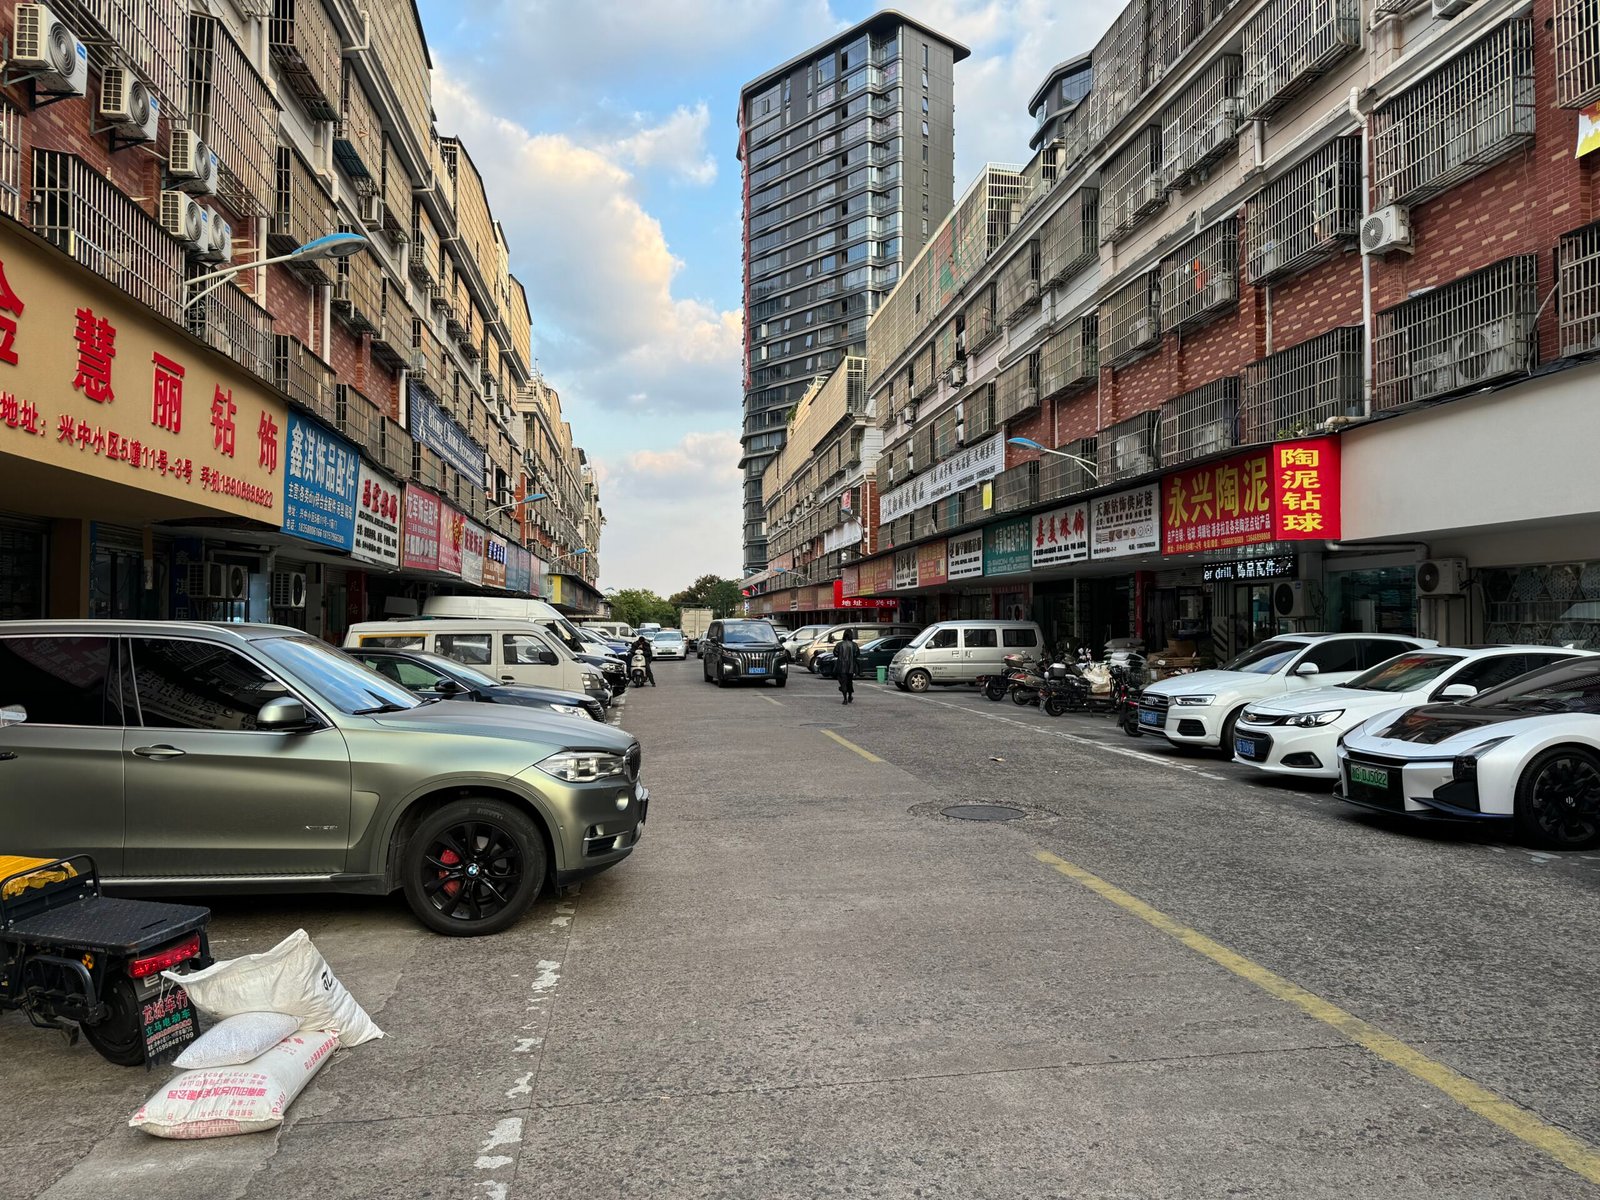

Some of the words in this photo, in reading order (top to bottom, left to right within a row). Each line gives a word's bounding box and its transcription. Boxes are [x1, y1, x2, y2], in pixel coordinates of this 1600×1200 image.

[1167, 456, 1270, 529] 永兴陶泥
[1280, 448, 1323, 533] 陶泥钻球
[146, 1008, 191, 1036] 立马电动车
